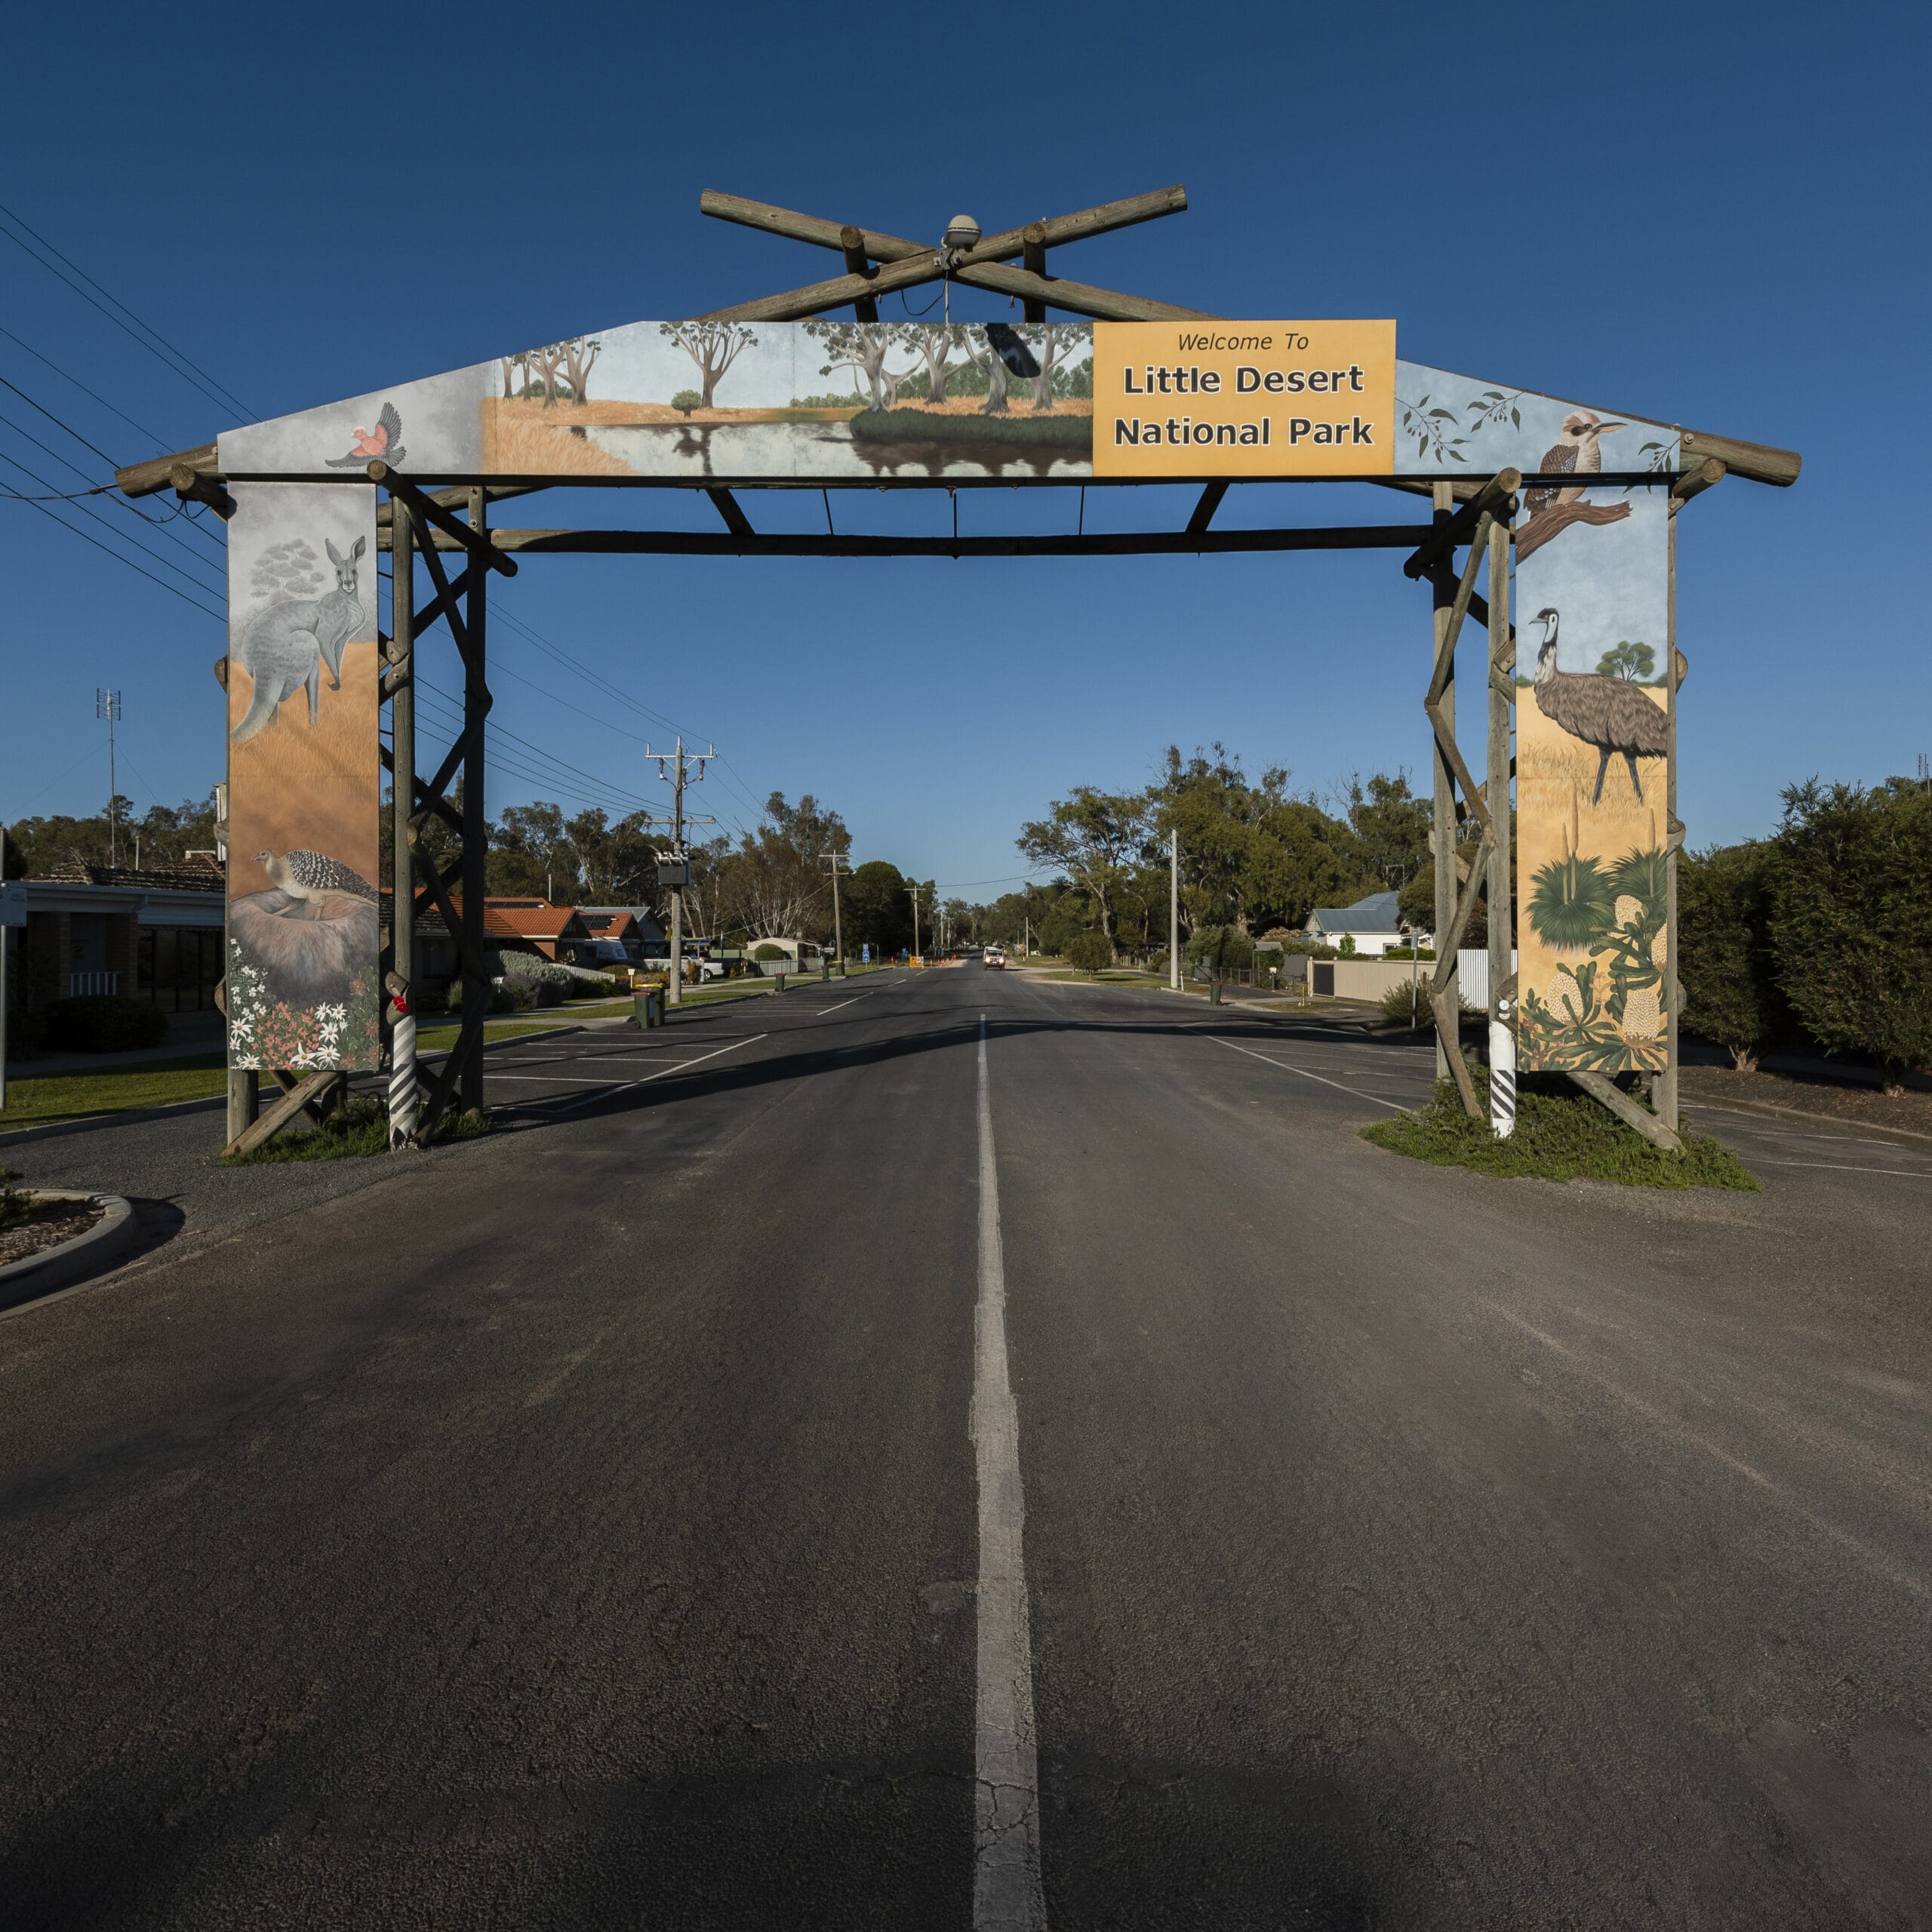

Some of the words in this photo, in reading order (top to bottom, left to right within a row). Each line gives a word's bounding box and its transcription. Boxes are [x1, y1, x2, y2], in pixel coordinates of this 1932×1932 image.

[1180, 333, 1272, 351] Welcome
[1285, 334, 1309, 350] To
[1124, 365, 1221, 395] Little
[1235, 365, 1364, 394] Desert
[1114, 417, 1271, 446] National
[1288, 416, 1375, 446] Park
